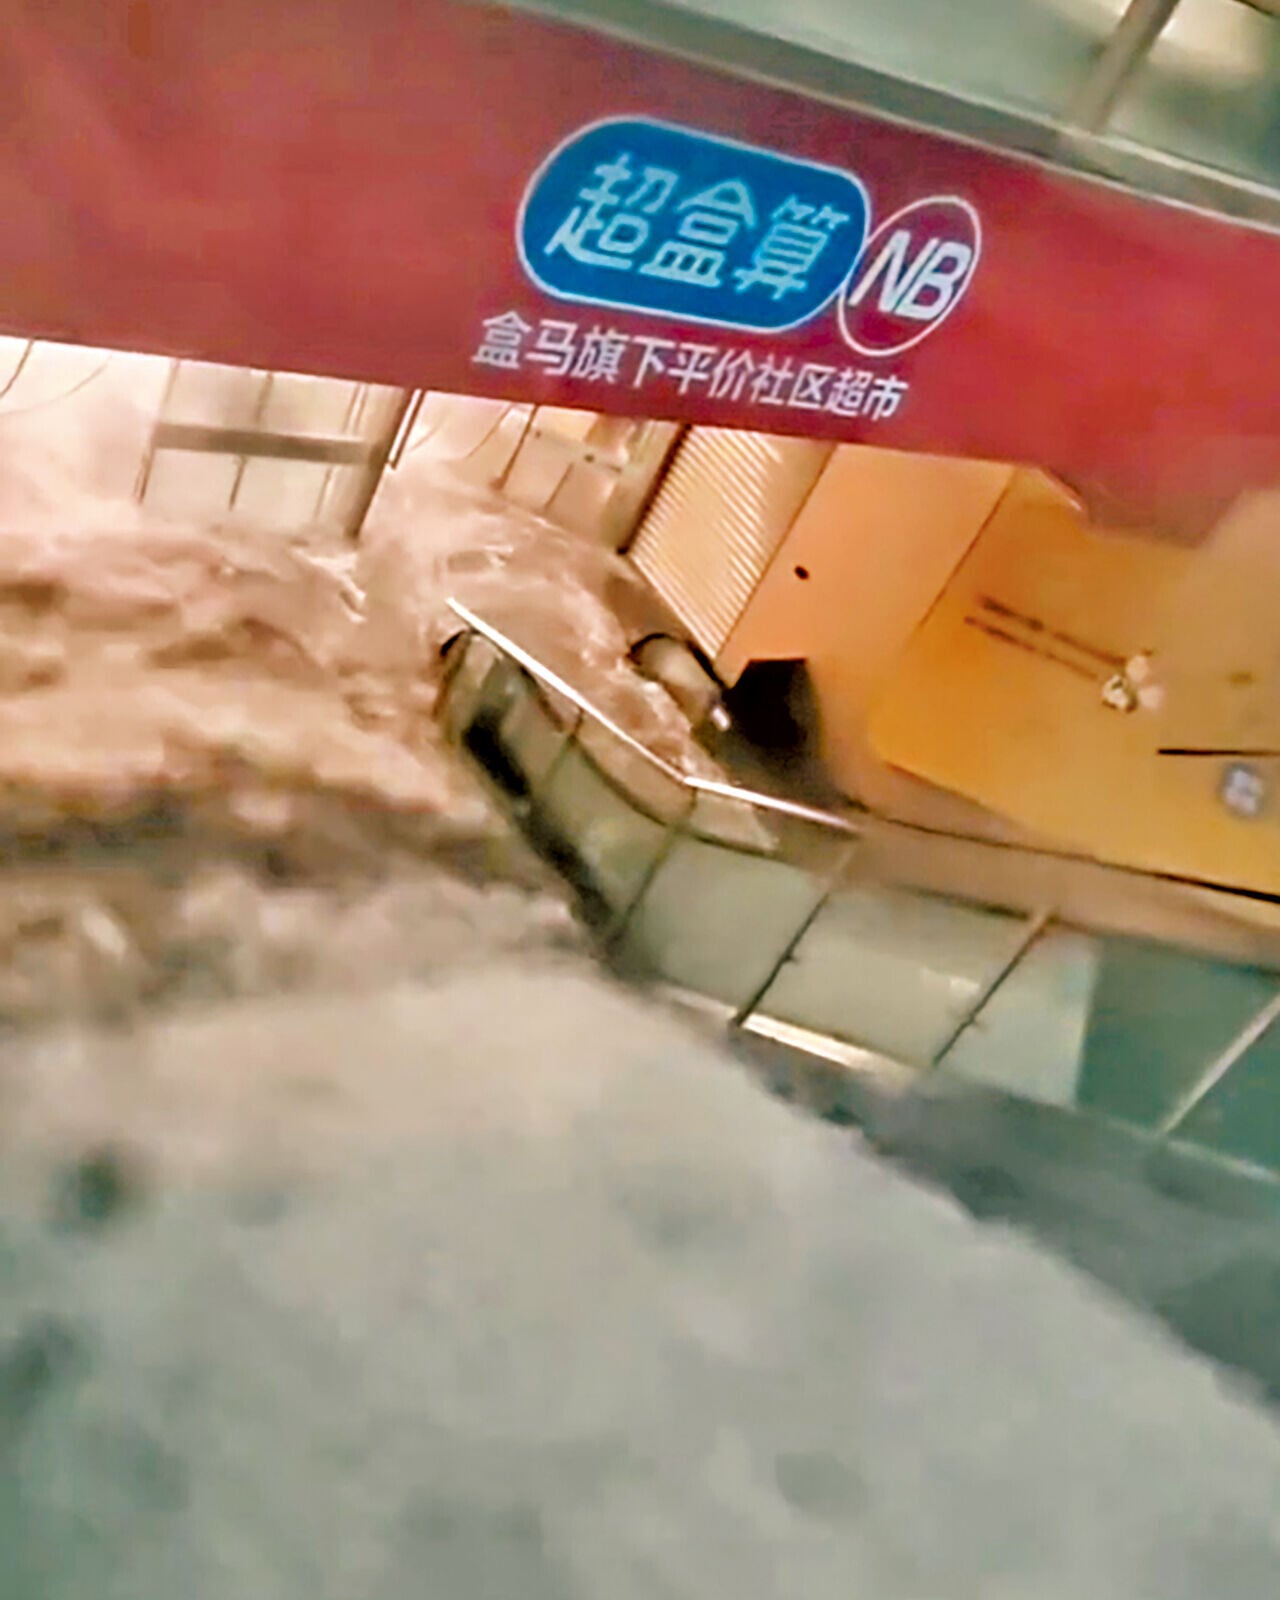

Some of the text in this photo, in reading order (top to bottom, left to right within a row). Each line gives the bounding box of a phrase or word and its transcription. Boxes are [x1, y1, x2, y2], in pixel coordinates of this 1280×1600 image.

[543, 151, 850, 300] 超盒算
[849, 230, 973, 320] NB
[471, 310, 909, 421] 盒马旗下平价社区超市
